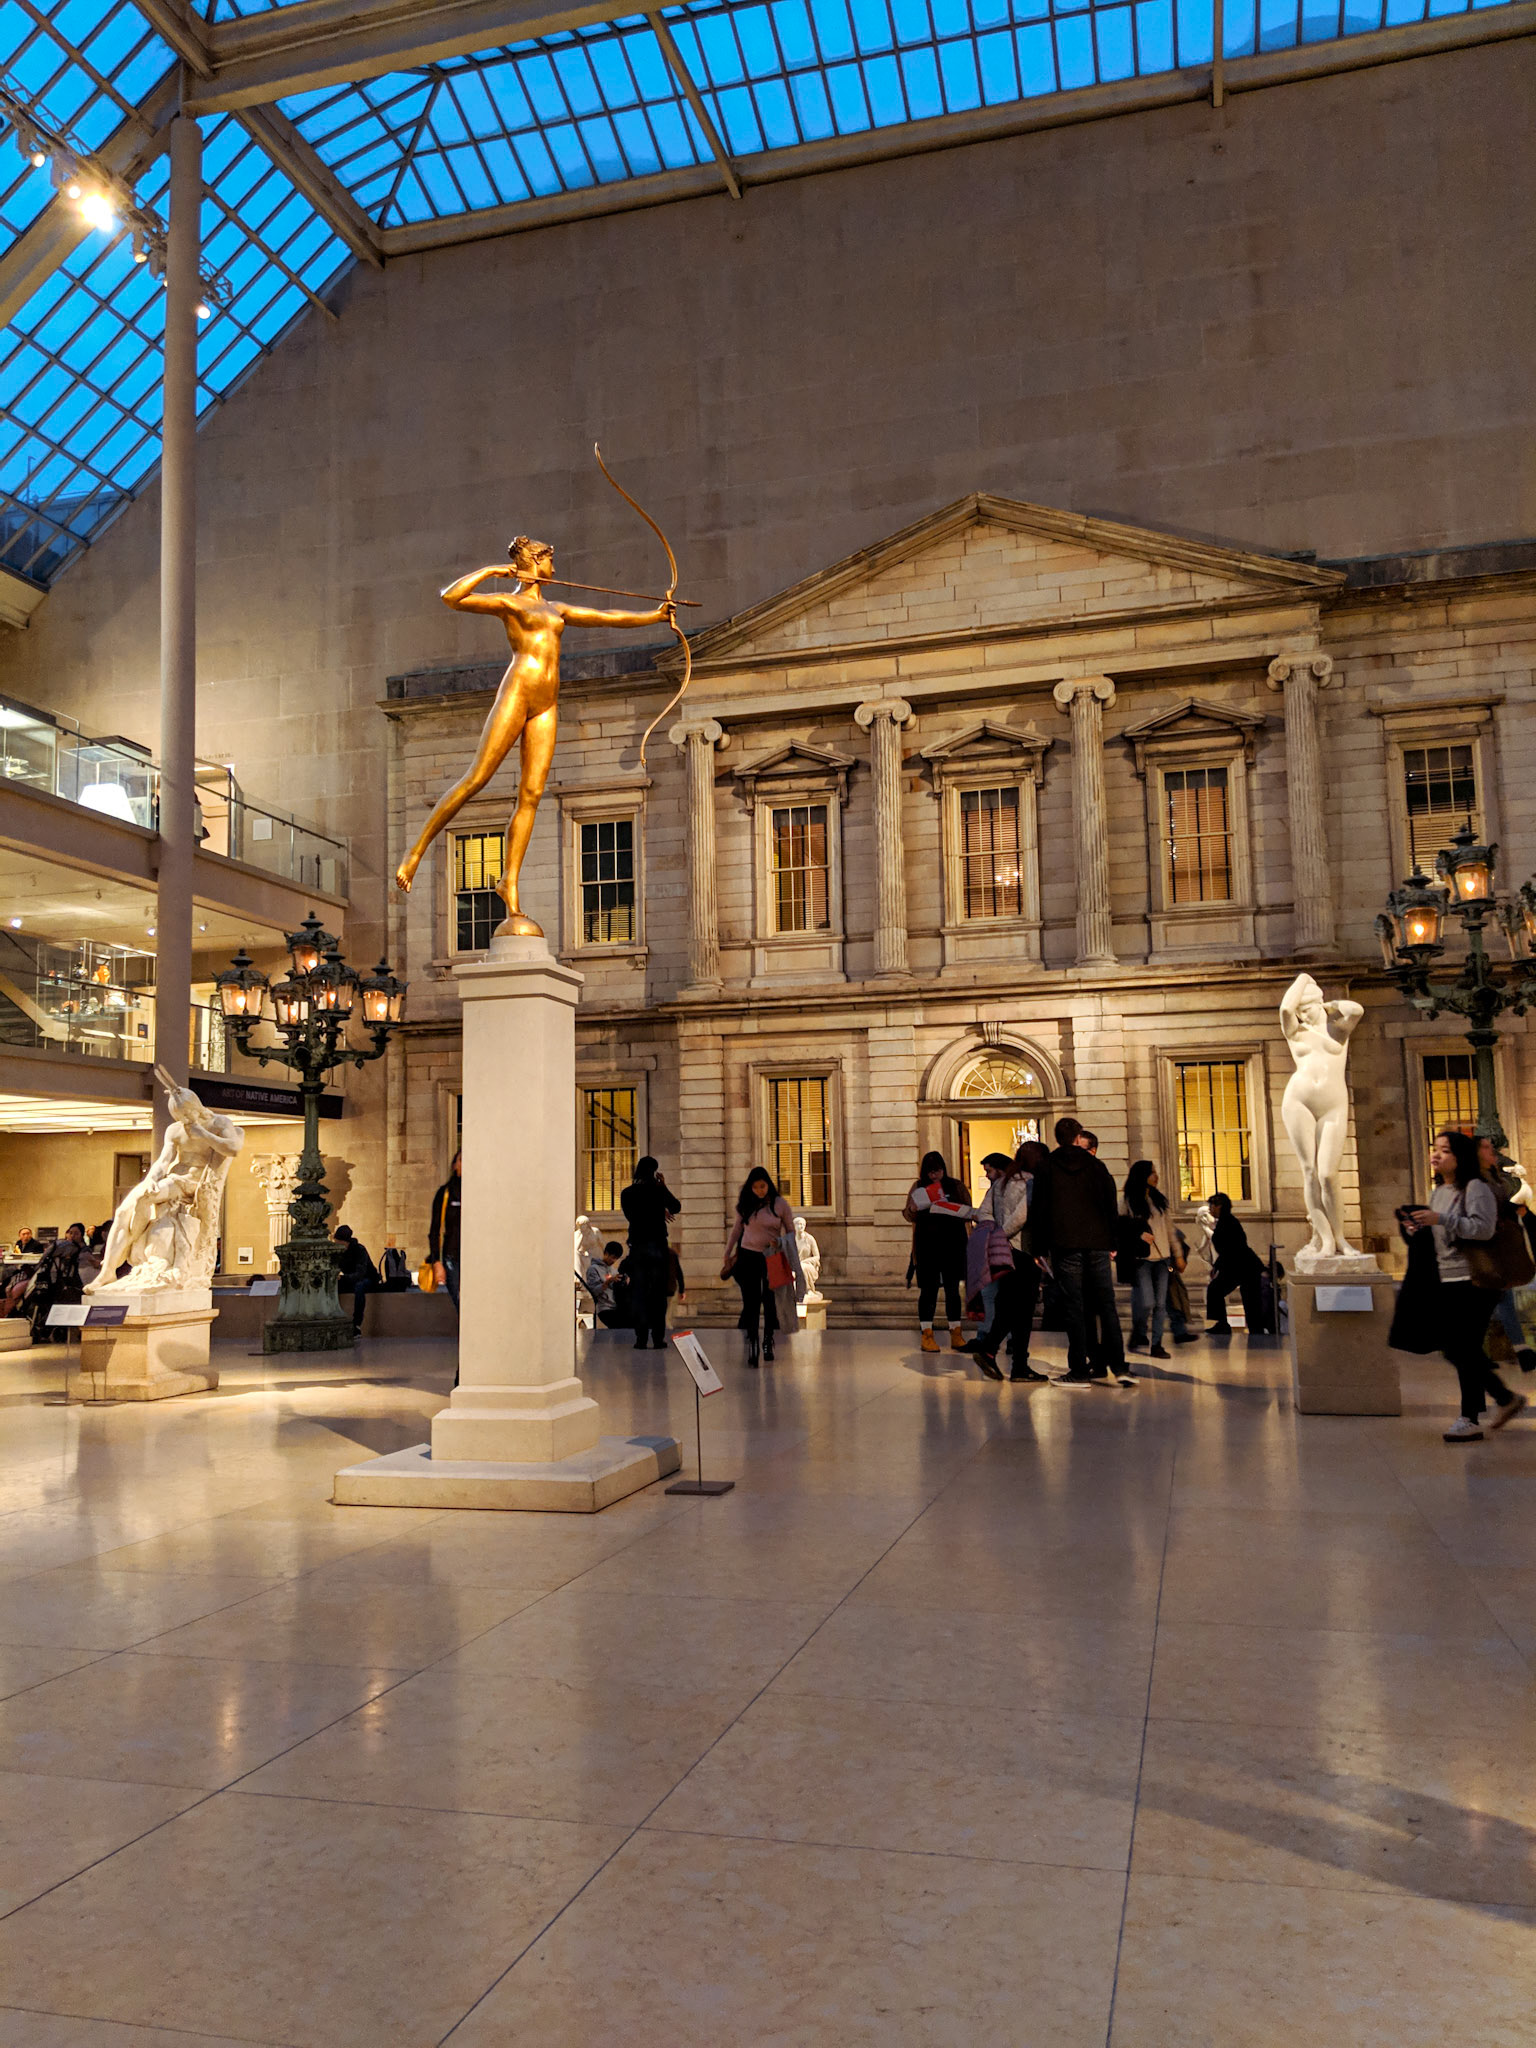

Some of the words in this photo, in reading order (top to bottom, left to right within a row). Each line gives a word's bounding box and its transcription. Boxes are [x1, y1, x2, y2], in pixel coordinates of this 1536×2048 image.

[222, 1088, 235, 1098] ART
[235, 1089, 244, 1098] OF
[245, 1090, 269, 1102] NATIVE
[270, 1093, 298, 1105] AMERICA
